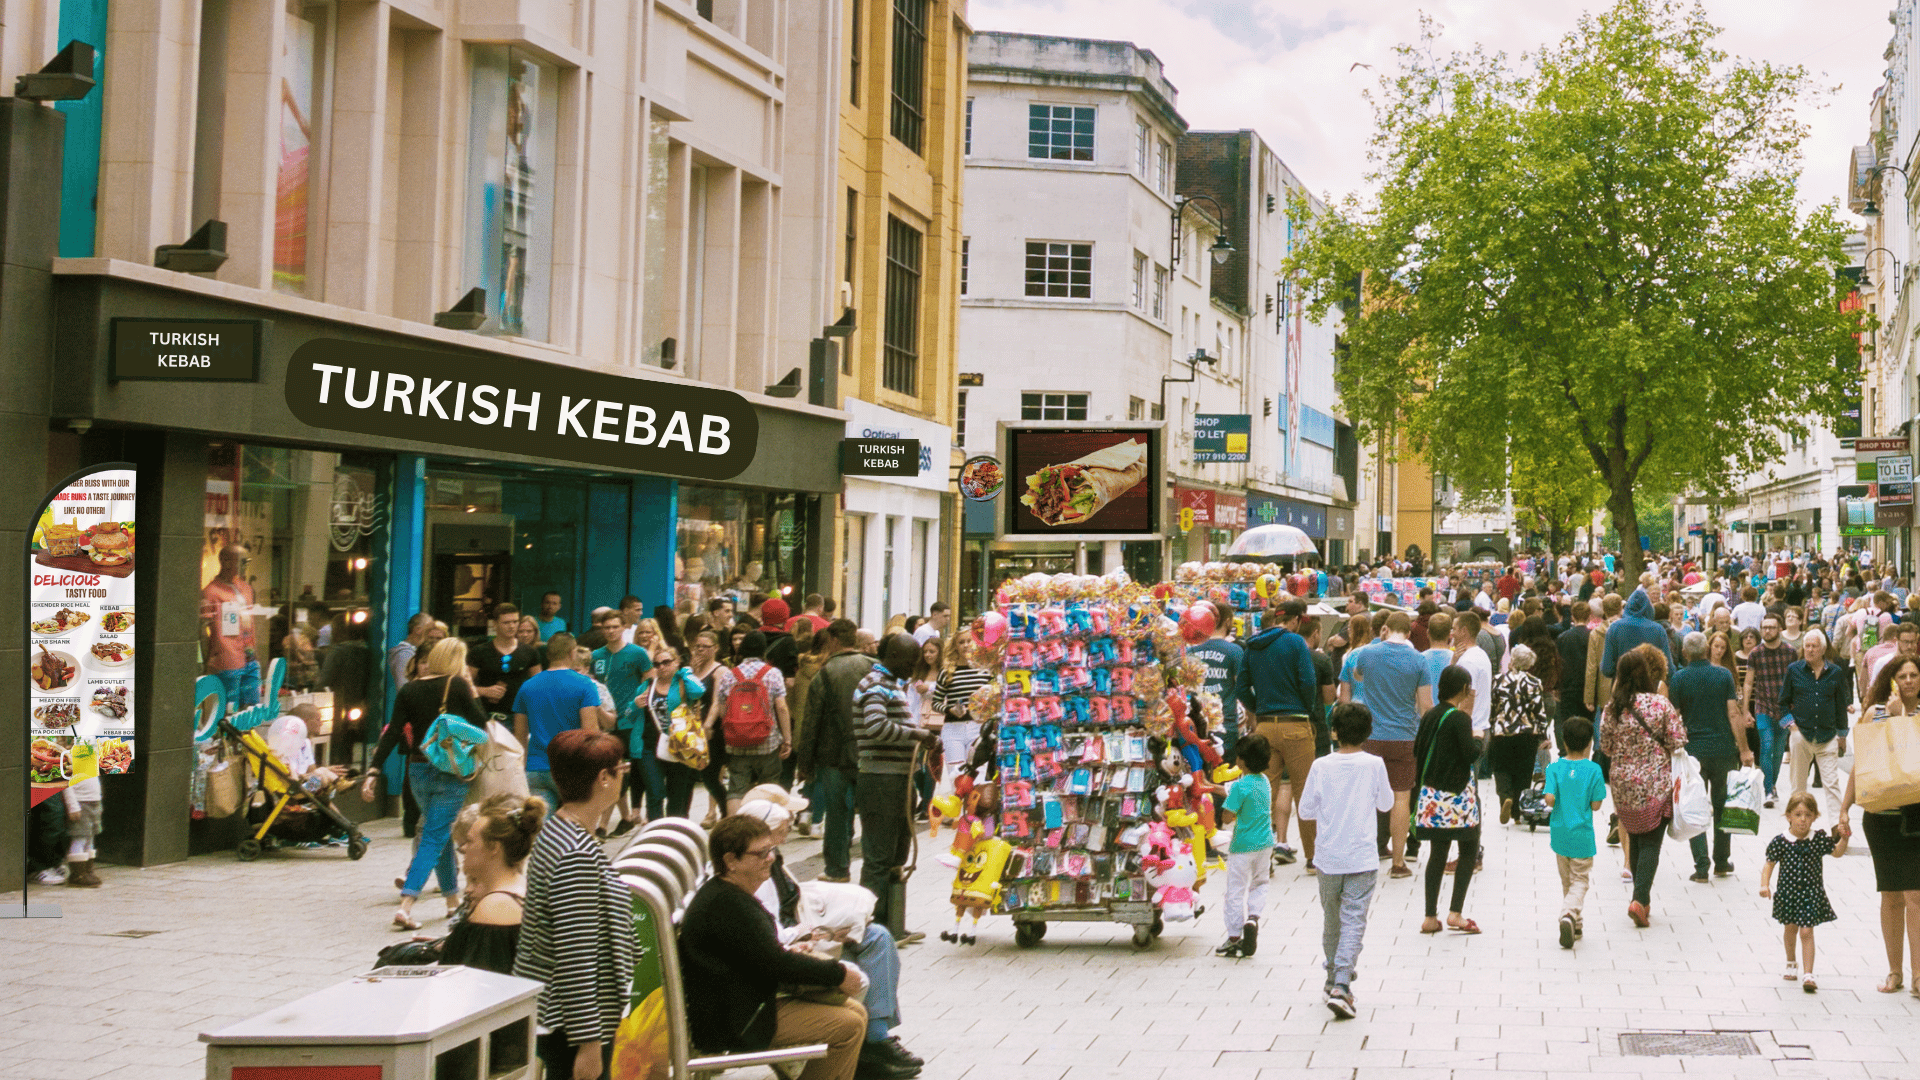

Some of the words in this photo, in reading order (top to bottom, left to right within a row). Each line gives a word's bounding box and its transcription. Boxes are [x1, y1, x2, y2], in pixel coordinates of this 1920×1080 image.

[149, 332, 220, 346] TURKISH
[158, 354, 211, 368] KEBAB
[312, 363, 541, 431] TURKISH
[557, 395, 732, 455] KEBAB
[1194, 418, 1220, 427] SHOP
[862, 428, 900, 439] Optical
[1194, 430, 1206, 438] TO
[1208, 430, 1226, 439] LET
[858, 444, 905, 454] TURKISH
[1859, 441, 1879, 449] SHOP
[1881, 441, 1890, 449] TO
[1892, 441, 1906, 449] LET
[863, 458, 900, 468] KEBAB
[1879, 464, 1891, 476] TO
[1893, 464, 1910, 475] LET
[85, 479, 100, 487] BLISS
[102, 479, 117, 487] WITH
[118, 479, 129, 487] OUR
[34, 575, 101, 586] DELICIOUS
[65, 588, 87, 598] TASTY
[89, 588, 107, 598] FOOD
[1205, 650, 1226, 663] BEACH
